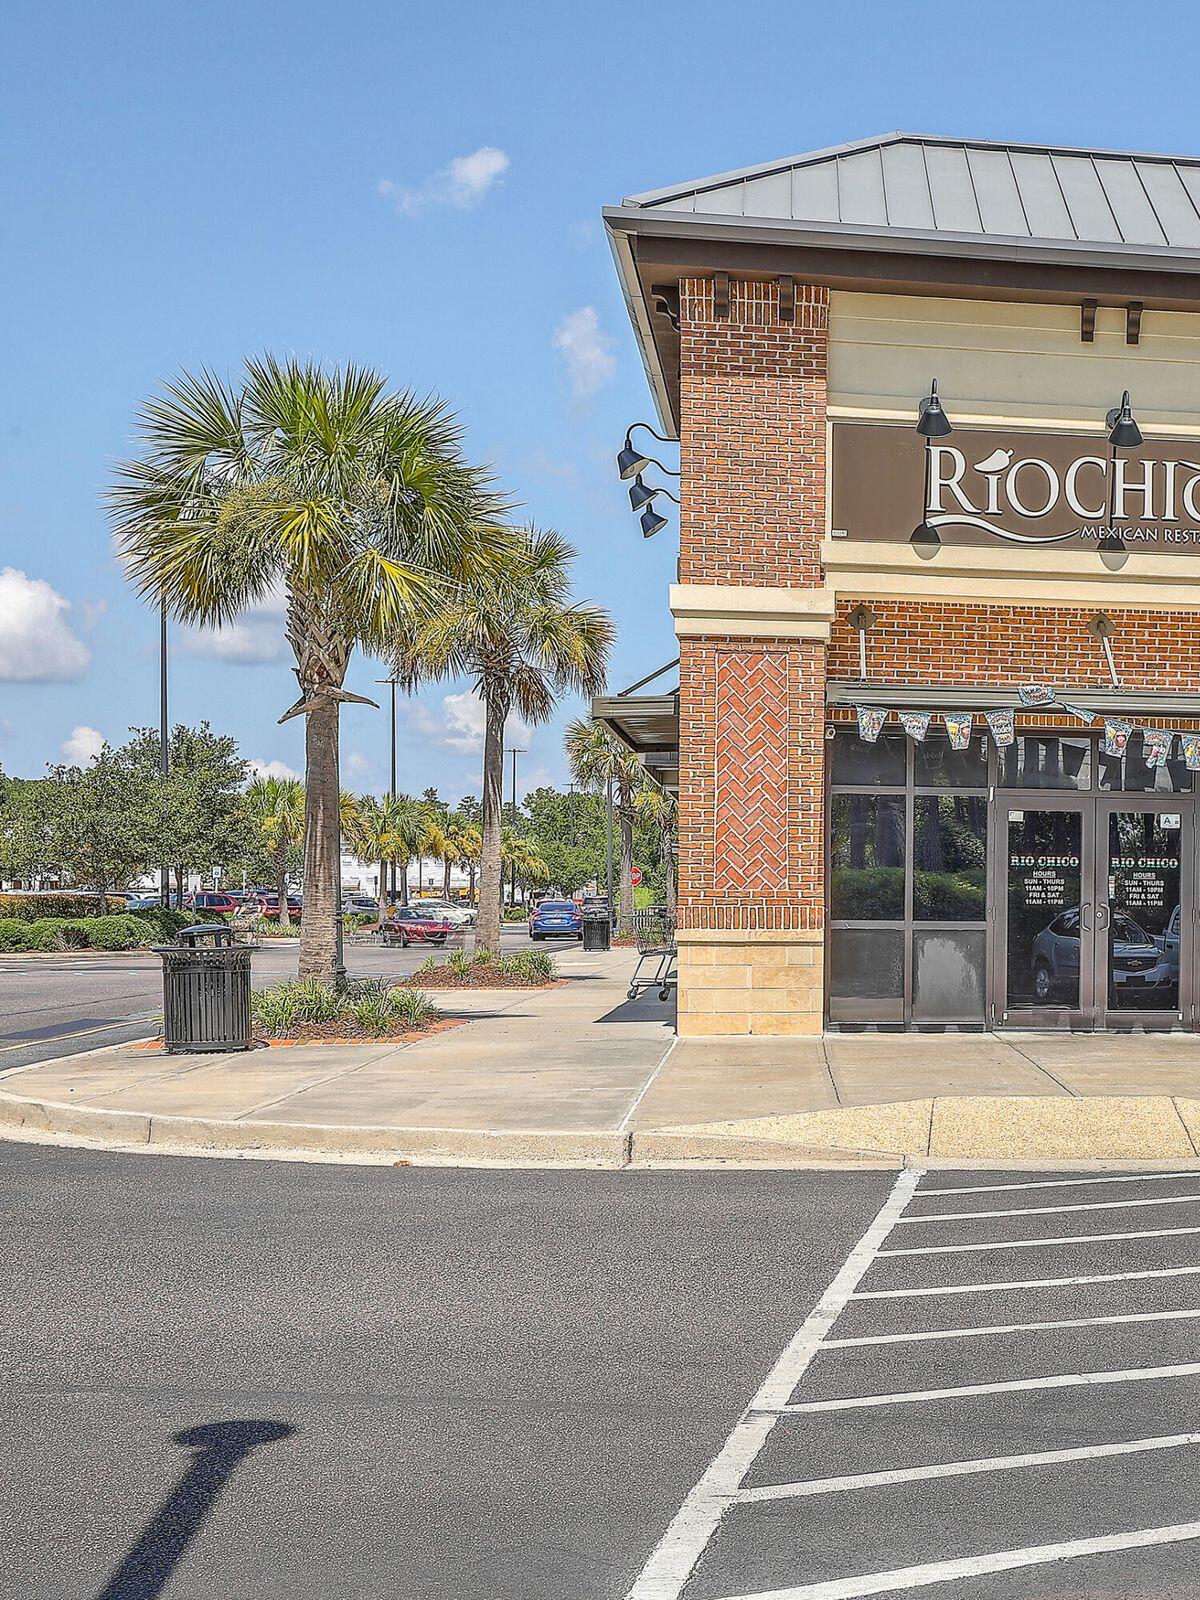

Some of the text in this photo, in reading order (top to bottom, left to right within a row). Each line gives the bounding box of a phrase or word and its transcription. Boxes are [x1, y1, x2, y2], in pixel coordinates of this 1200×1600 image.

[1080, 525, 1157, 541] MEXICAN
[1163, 816, 1171, 824] A
[1010, 855, 1079, 867] RIO CHICO
[1110, 857, 1179, 868] RIO CHICO
